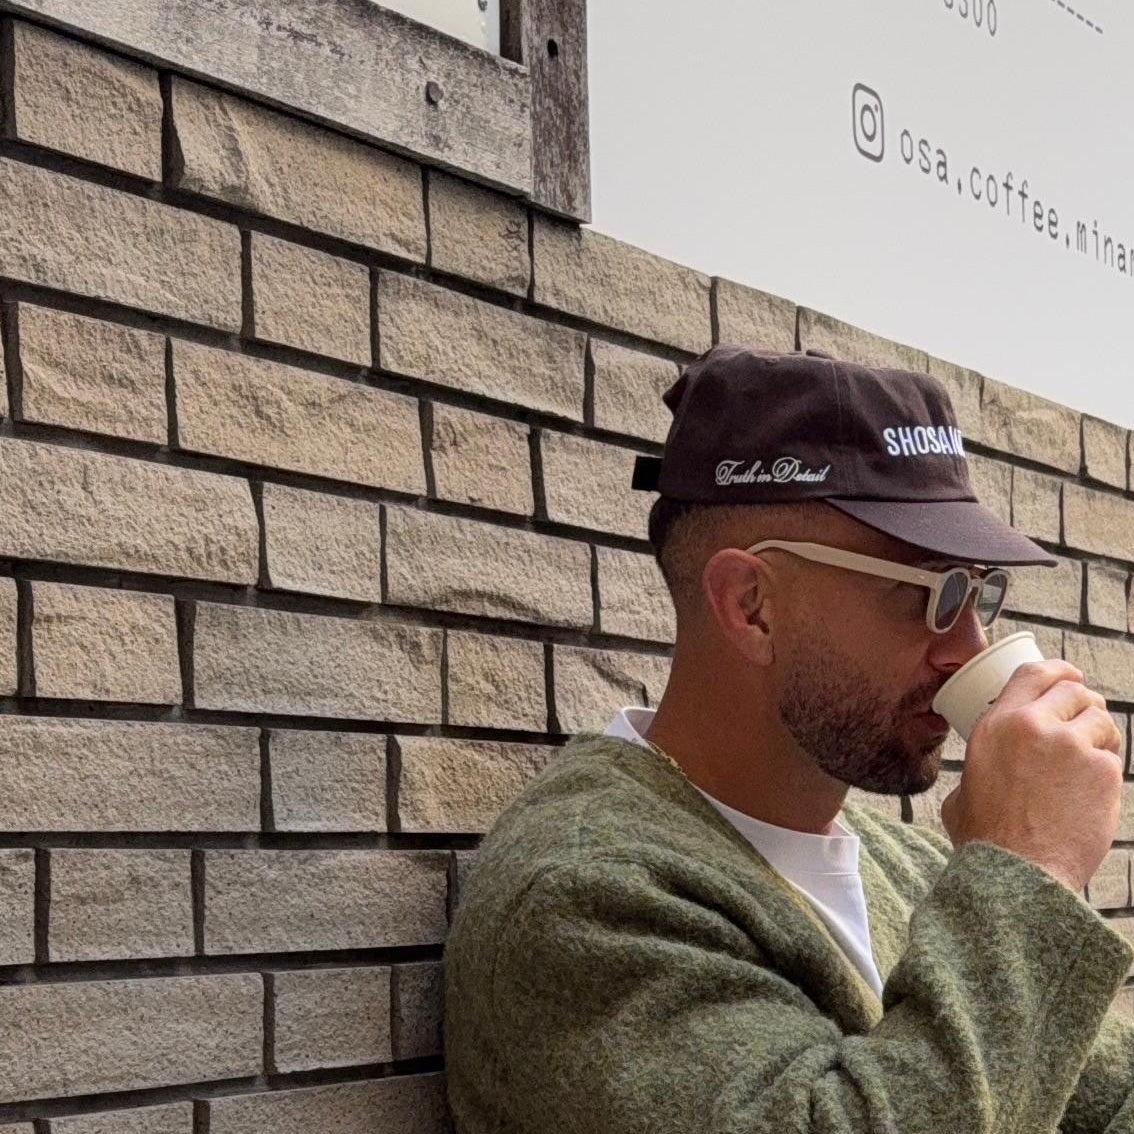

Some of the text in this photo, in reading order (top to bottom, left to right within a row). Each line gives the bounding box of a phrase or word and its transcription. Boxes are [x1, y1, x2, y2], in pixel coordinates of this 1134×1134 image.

[715, 456, 831, 485] Truth in Detail
